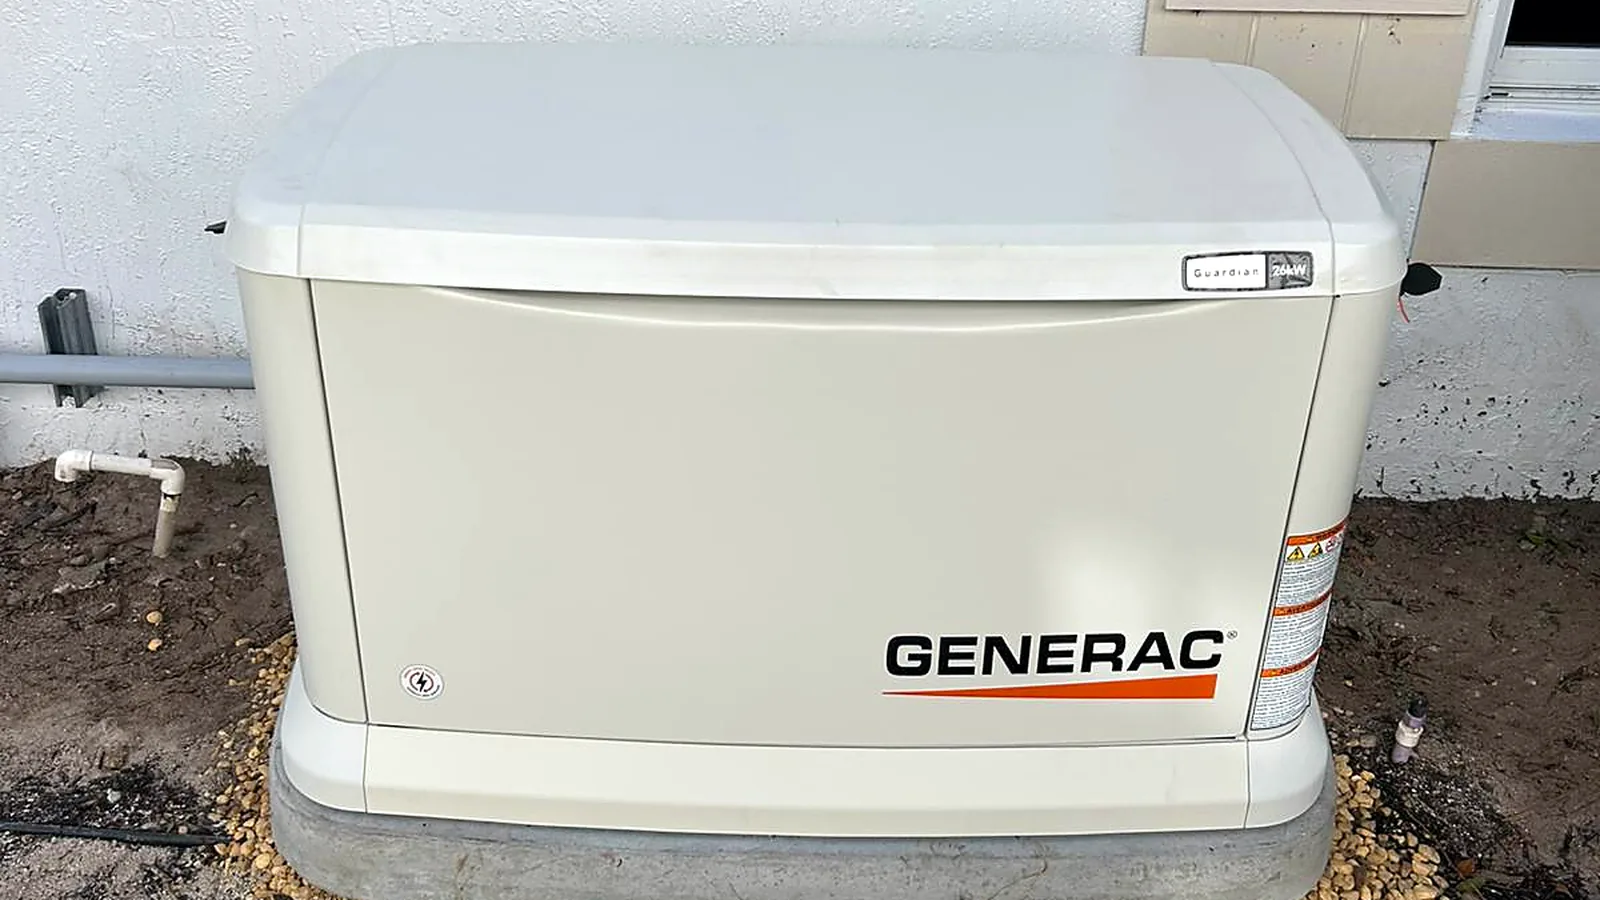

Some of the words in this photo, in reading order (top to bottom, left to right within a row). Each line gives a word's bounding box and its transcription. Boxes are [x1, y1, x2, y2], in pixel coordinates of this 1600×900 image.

[1194, 268, 1259, 277] Guardian
[1272, 264, 1307, 277] 26kW
[886, 630, 1224, 676] GENERAC
